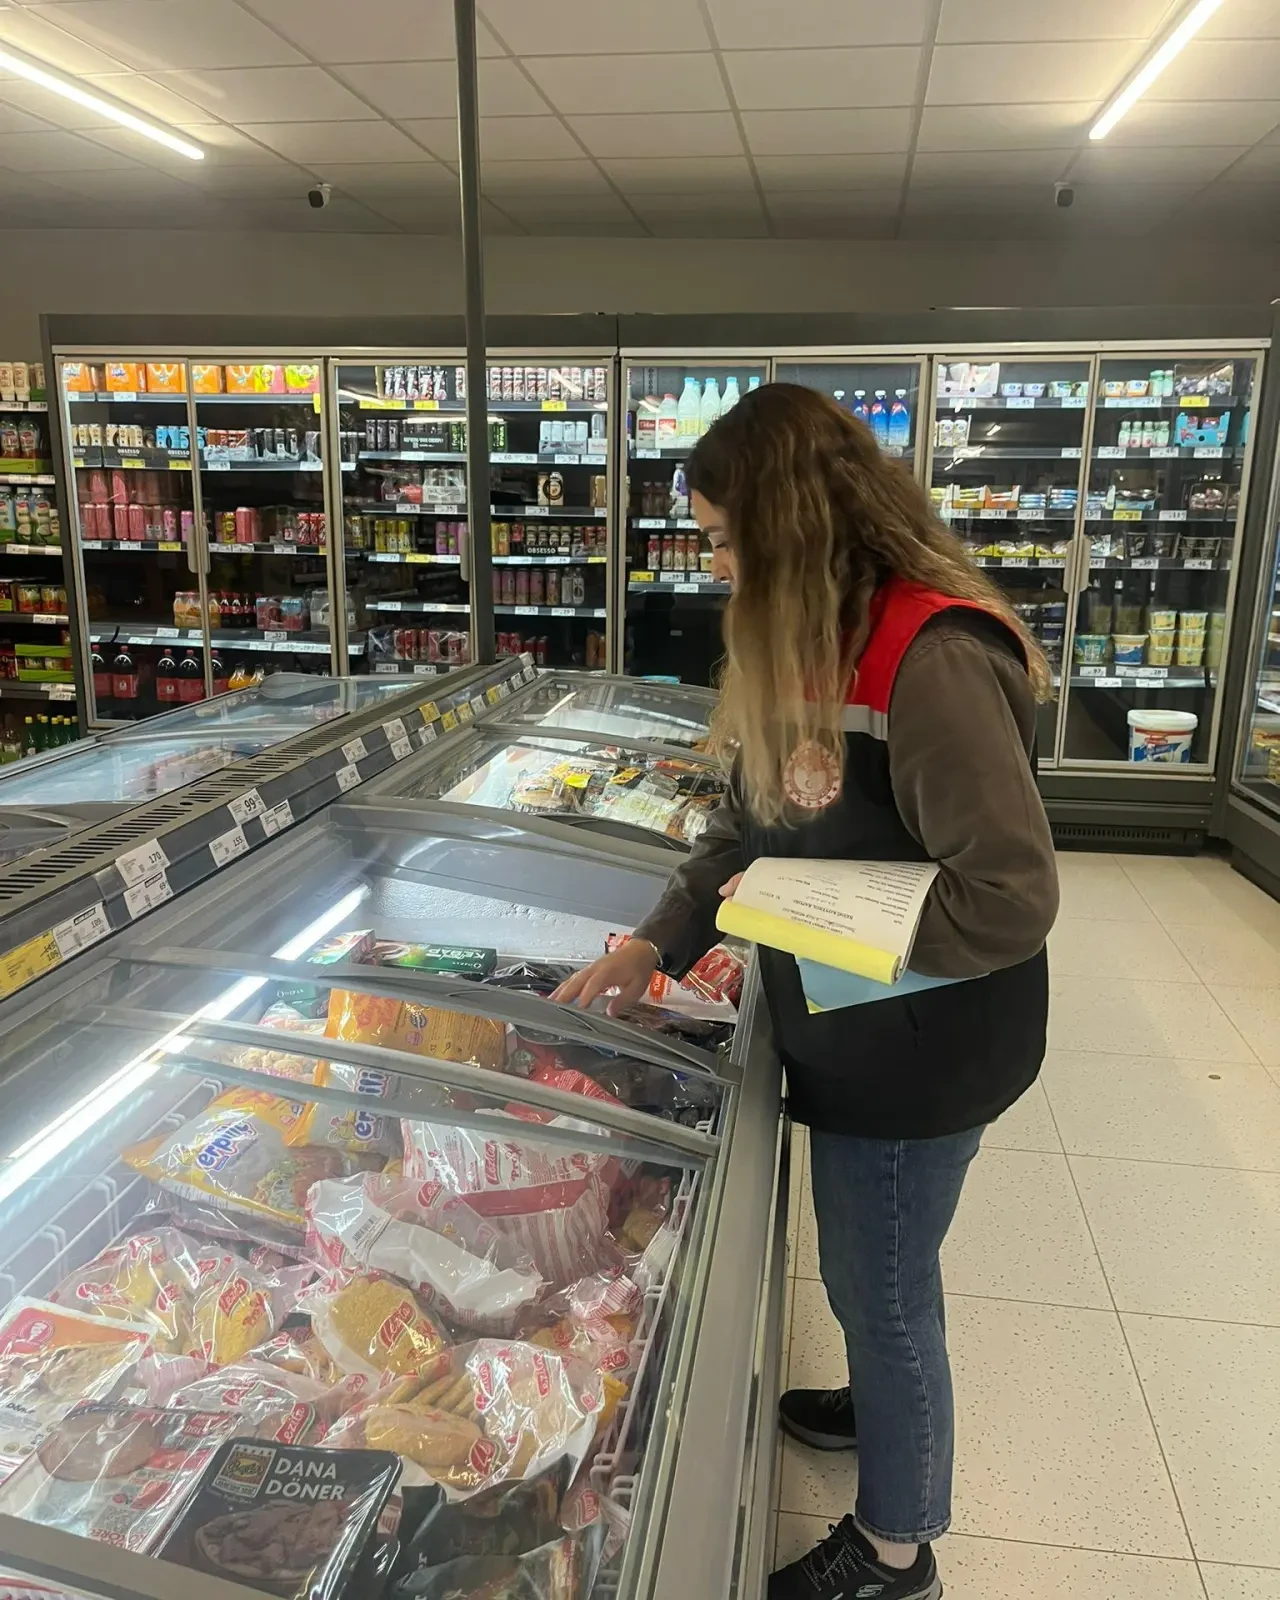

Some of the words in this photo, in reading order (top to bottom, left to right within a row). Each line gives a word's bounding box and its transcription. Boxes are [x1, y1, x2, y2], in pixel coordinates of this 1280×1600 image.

[244, 798, 257, 811] 99
[149, 851, 162, 864] 170
[426, 948, 485, 960] KEBAP
[274, 1457, 337, 1479] DANA
[265, 1478, 345, 1501] DÖNER
